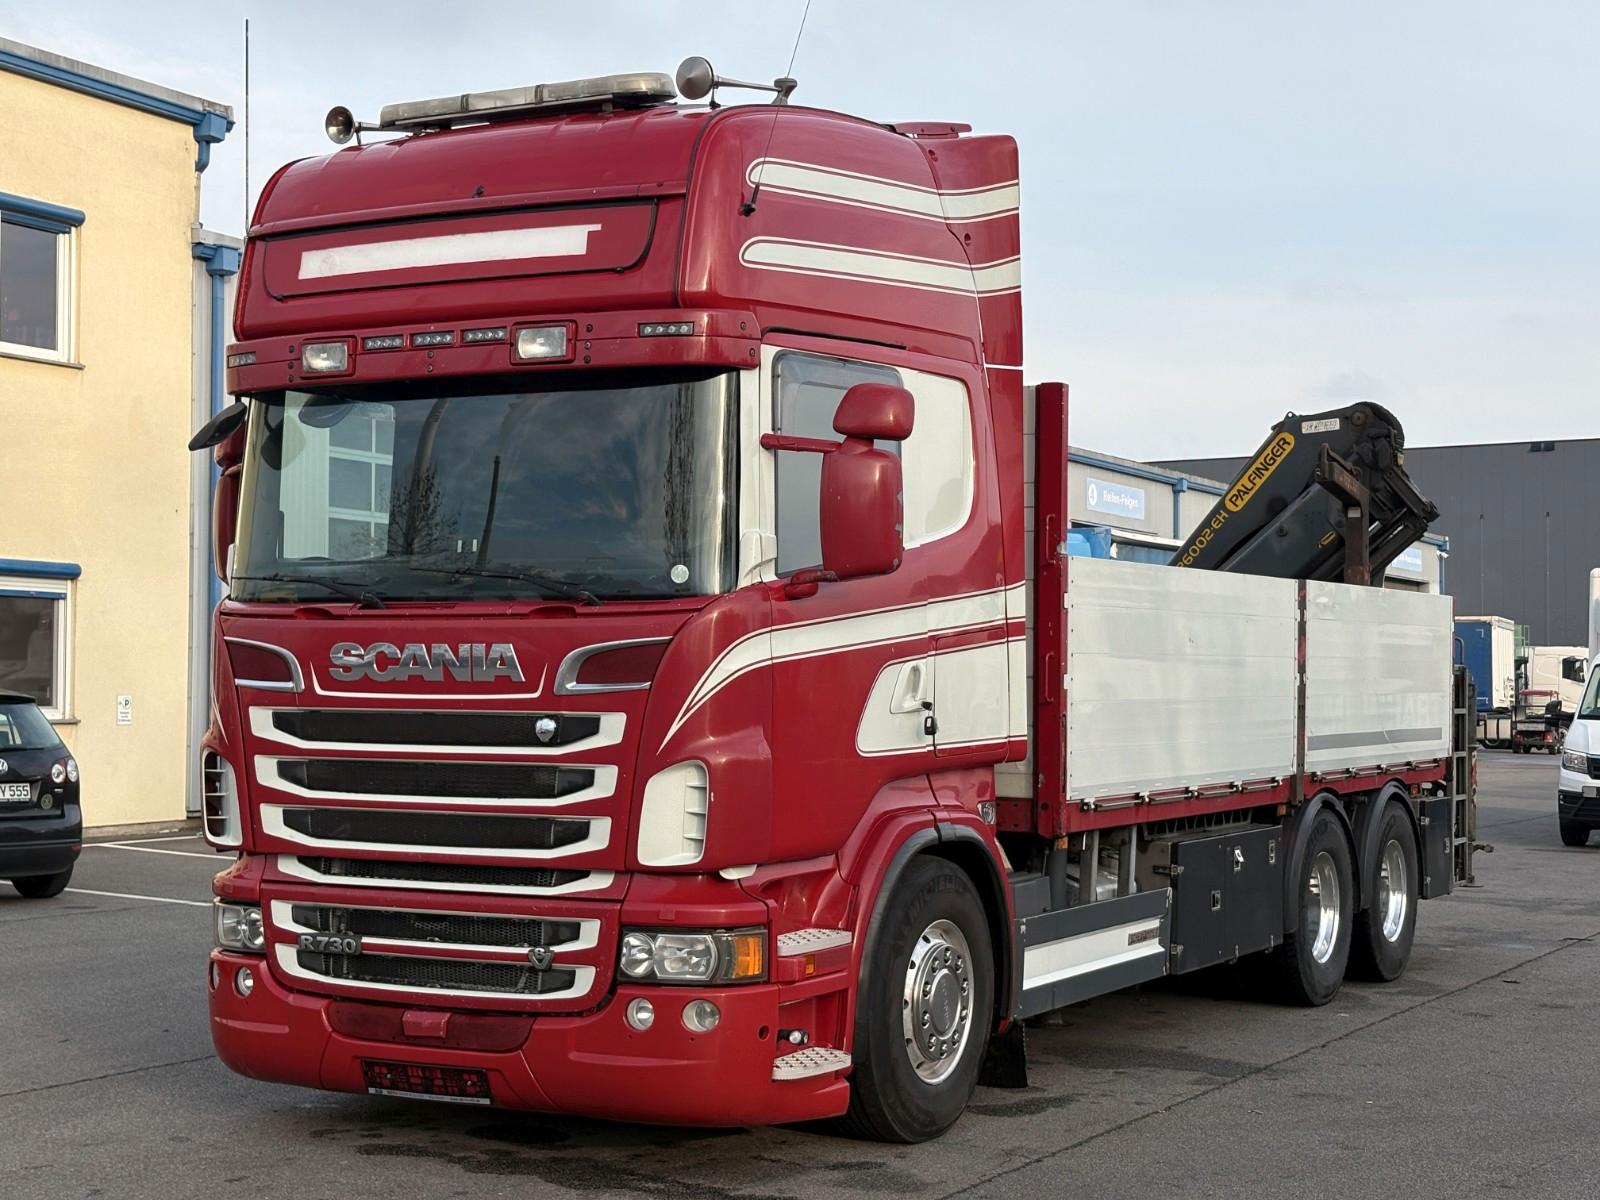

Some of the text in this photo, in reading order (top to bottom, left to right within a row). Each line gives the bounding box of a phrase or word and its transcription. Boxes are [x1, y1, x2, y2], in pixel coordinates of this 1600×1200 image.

[1228, 437, 1291, 507] PALFINGER
[328, 642, 526, 682] SCANIA
[9, 785, 29, 797] 555
